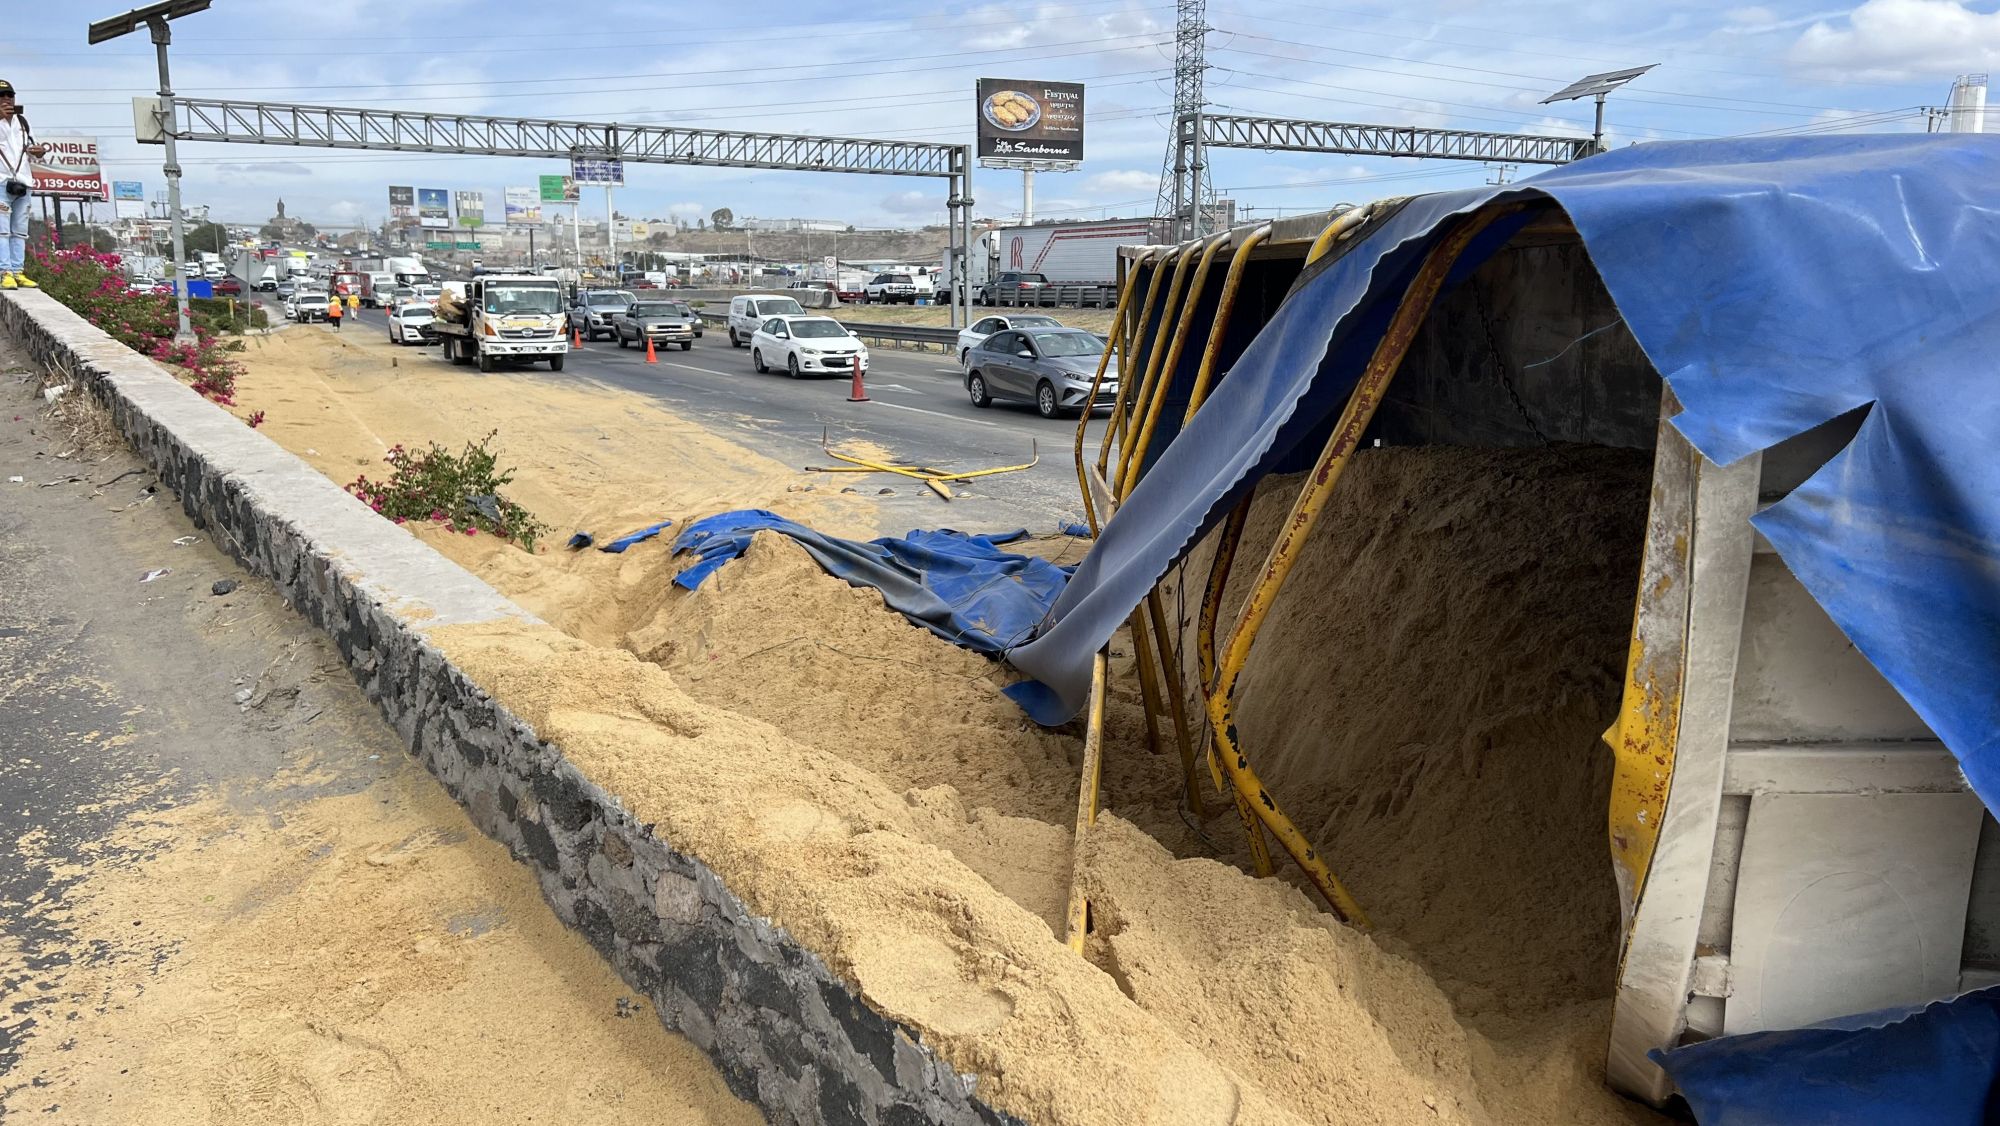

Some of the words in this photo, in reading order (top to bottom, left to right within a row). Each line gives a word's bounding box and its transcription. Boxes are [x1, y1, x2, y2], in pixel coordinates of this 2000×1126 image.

[38, 142, 97, 154] ONIBLE
[1014, 141, 1069, 154] Sanborns
[58, 156, 98, 166] VENTA
[45, 178, 100, 189] 139-0650
